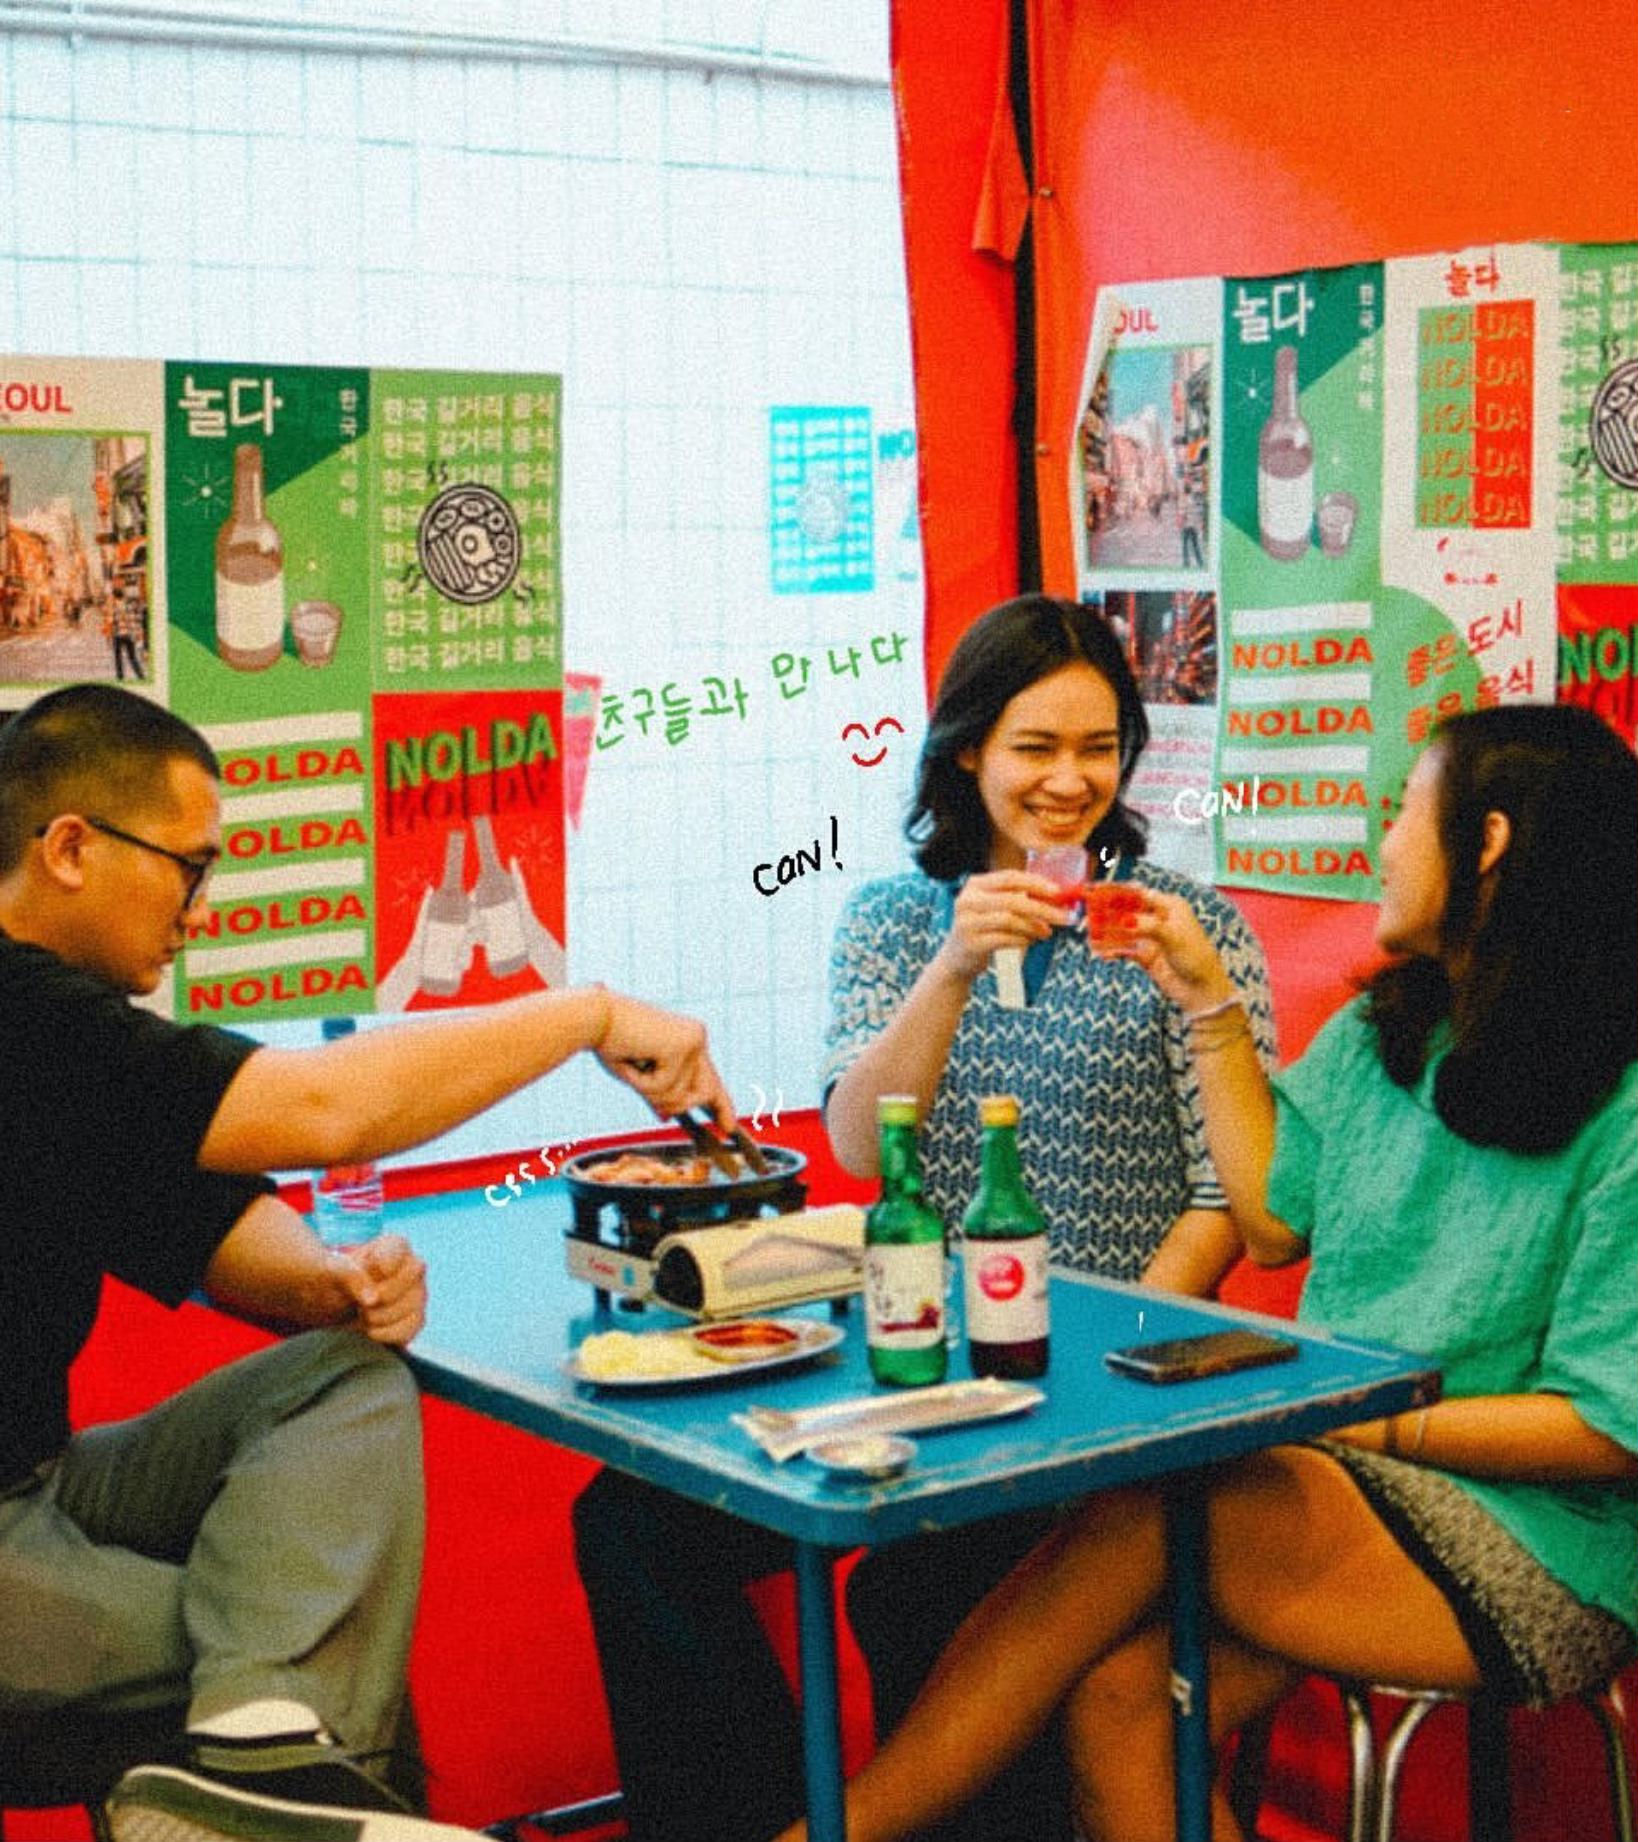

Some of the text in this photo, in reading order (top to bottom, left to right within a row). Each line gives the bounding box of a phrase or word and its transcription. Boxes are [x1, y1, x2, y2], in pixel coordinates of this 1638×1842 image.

[1233, 281, 1315, 344] 놀다
[1423, 309, 1529, 344] NOLDA
[1423, 354, 1528, 389] NOLDA
[0, 383, 73, 412] OUL
[177, 375, 284, 438] 놀다
[1421, 402, 1527, 433] NOLDA
[1421, 447, 1527, 478] NOLDA
[1420, 492, 1526, 523] NOLDA
[1231, 635, 1373, 672] NOLDA
[1406, 597, 1523, 689] 좋은 도시
[1227, 704, 1373, 739] NOLDA
[221, 747, 365, 788] OLDA
[387, 712, 558, 791] NOLDA
[1223, 778, 1369, 809] NOLDA
[219, 818, 367, 862] OLDA
[1227, 847, 1373, 877] NOLDA
[189, 963, 369, 1013] NOLDA
